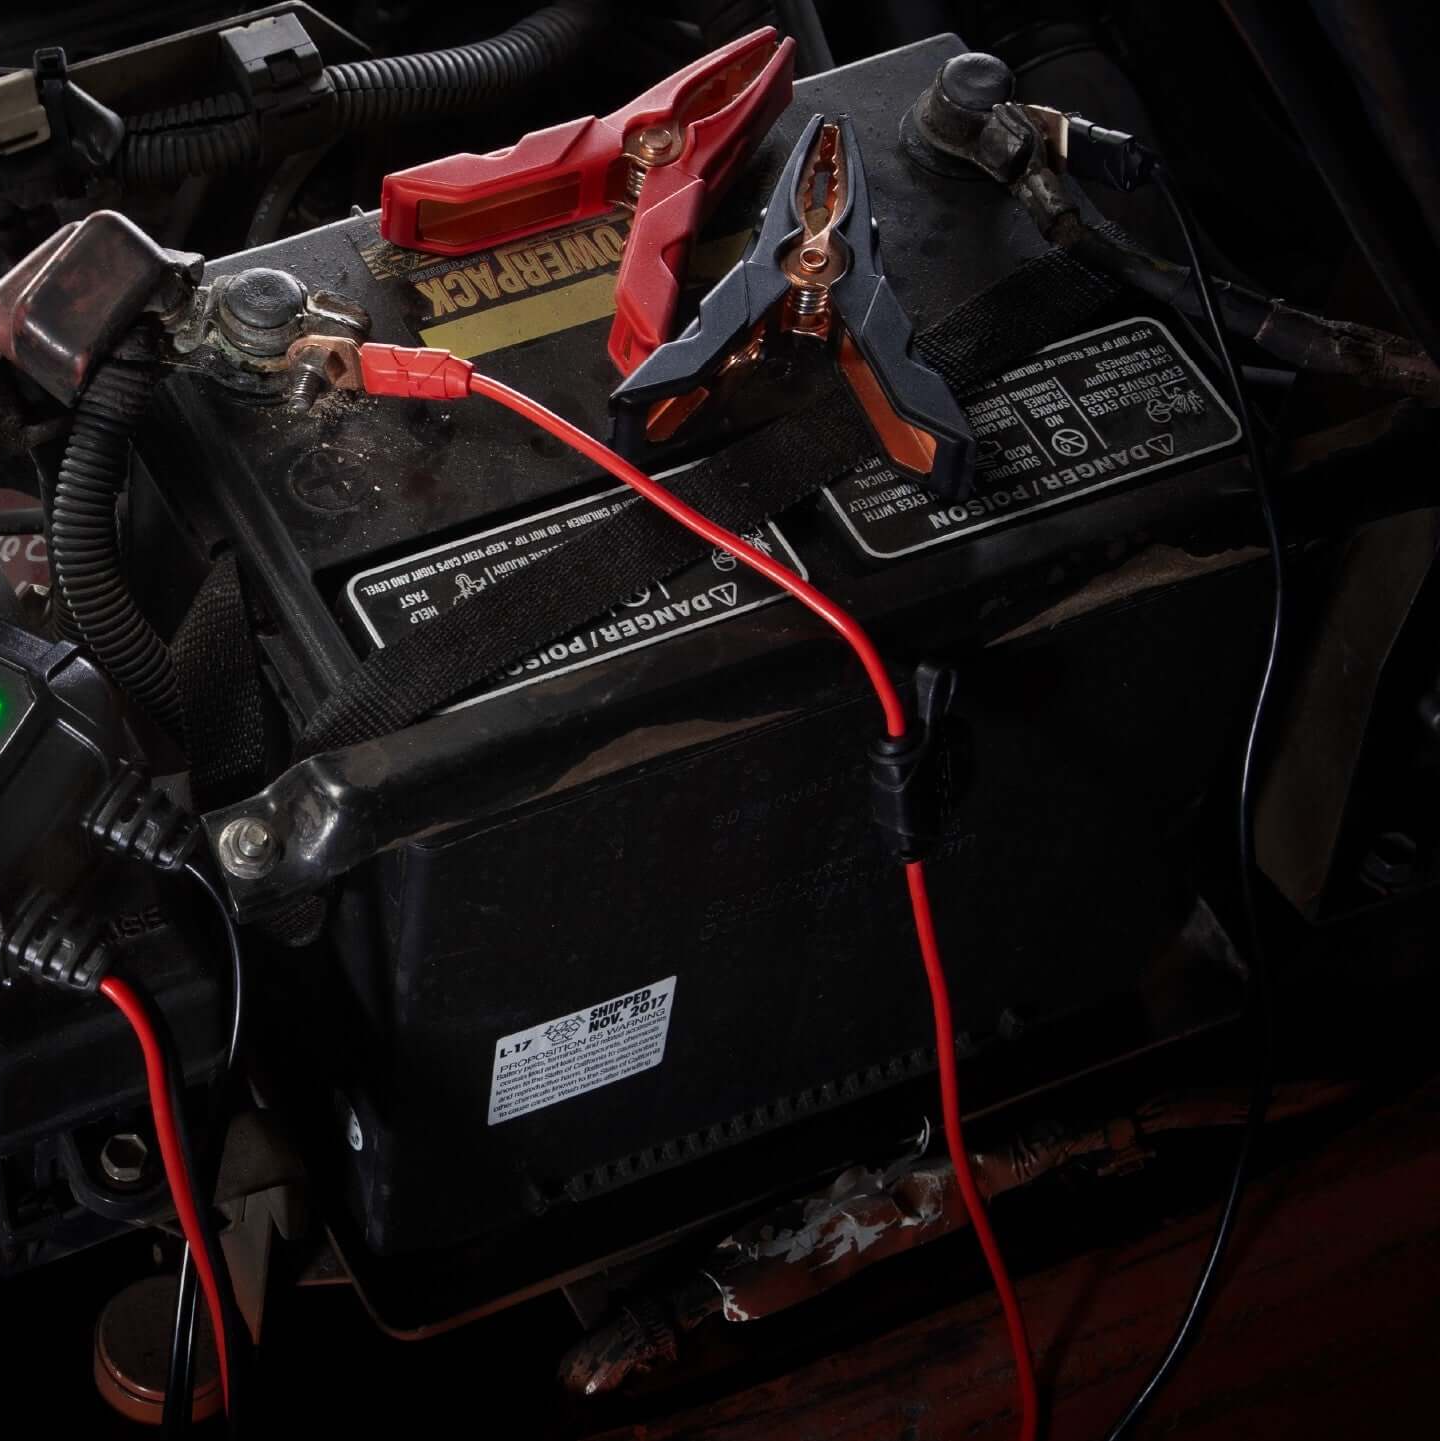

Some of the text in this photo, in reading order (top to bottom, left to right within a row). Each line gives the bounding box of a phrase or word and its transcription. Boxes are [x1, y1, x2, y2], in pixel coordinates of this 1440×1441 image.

[415, 225, 628, 317] OWERPACK
[1102, 341, 1113, 351] OF
[1113, 336, 1130, 347] OUT
[1149, 344, 1166, 355] OR
[1083, 346, 1101, 356] THE
[1043, 359, 1056, 369] OF
[1118, 358, 1151, 376] CAUSE
[1009, 380, 1056, 401] SMOKING
[1079, 366, 1183, 406] EXPLOSIVE GASES
[966, 396, 1005, 415] SEVERE
[1023, 390, 1063, 408] FLAMES
[1088, 387, 1161, 416] SHIELD EYES
[969, 406, 1011, 426] BLINDNE
[1030, 399, 1070, 418] SPARKS
[1045, 414, 1064, 427] NO
[1004, 444, 1032, 460] ACID
[980, 455, 1041, 482] SULFURIC
[1041, 445, 1149, 489] DANGER
[854, 470, 898, 489] EDICAL
[863, 494, 928, 522] EYES WITH
[928, 486, 1028, 528] POISON
[567, 508, 610, 528] CHILDREN
[529, 529, 547, 541] NOT
[547, 524, 561, 535] DO
[485, 541, 508, 555] KEEP
[515, 535, 529, 546] TIP
[436, 557, 461, 571] CAPS
[461, 549, 485, 563] VENT
[411, 565, 437, 581] TIGHT
[493, 556, 529, 575] INJURY
[390, 574, 410, 587] AND
[400, 590, 429, 608] FAST
[410, 605, 439, 623] HELP
[600, 594, 711, 641] DANGER
[589, 993, 667, 1033] NOV. 2017
[590, 990, 650, 1020] SHIPPED
[500, 1038, 586, 1072] PROPOSITION
[589, 1031, 603, 1042] 65
[607, 1008, 665, 1035] WARNING
[500, 1039, 532, 1058] L-17
